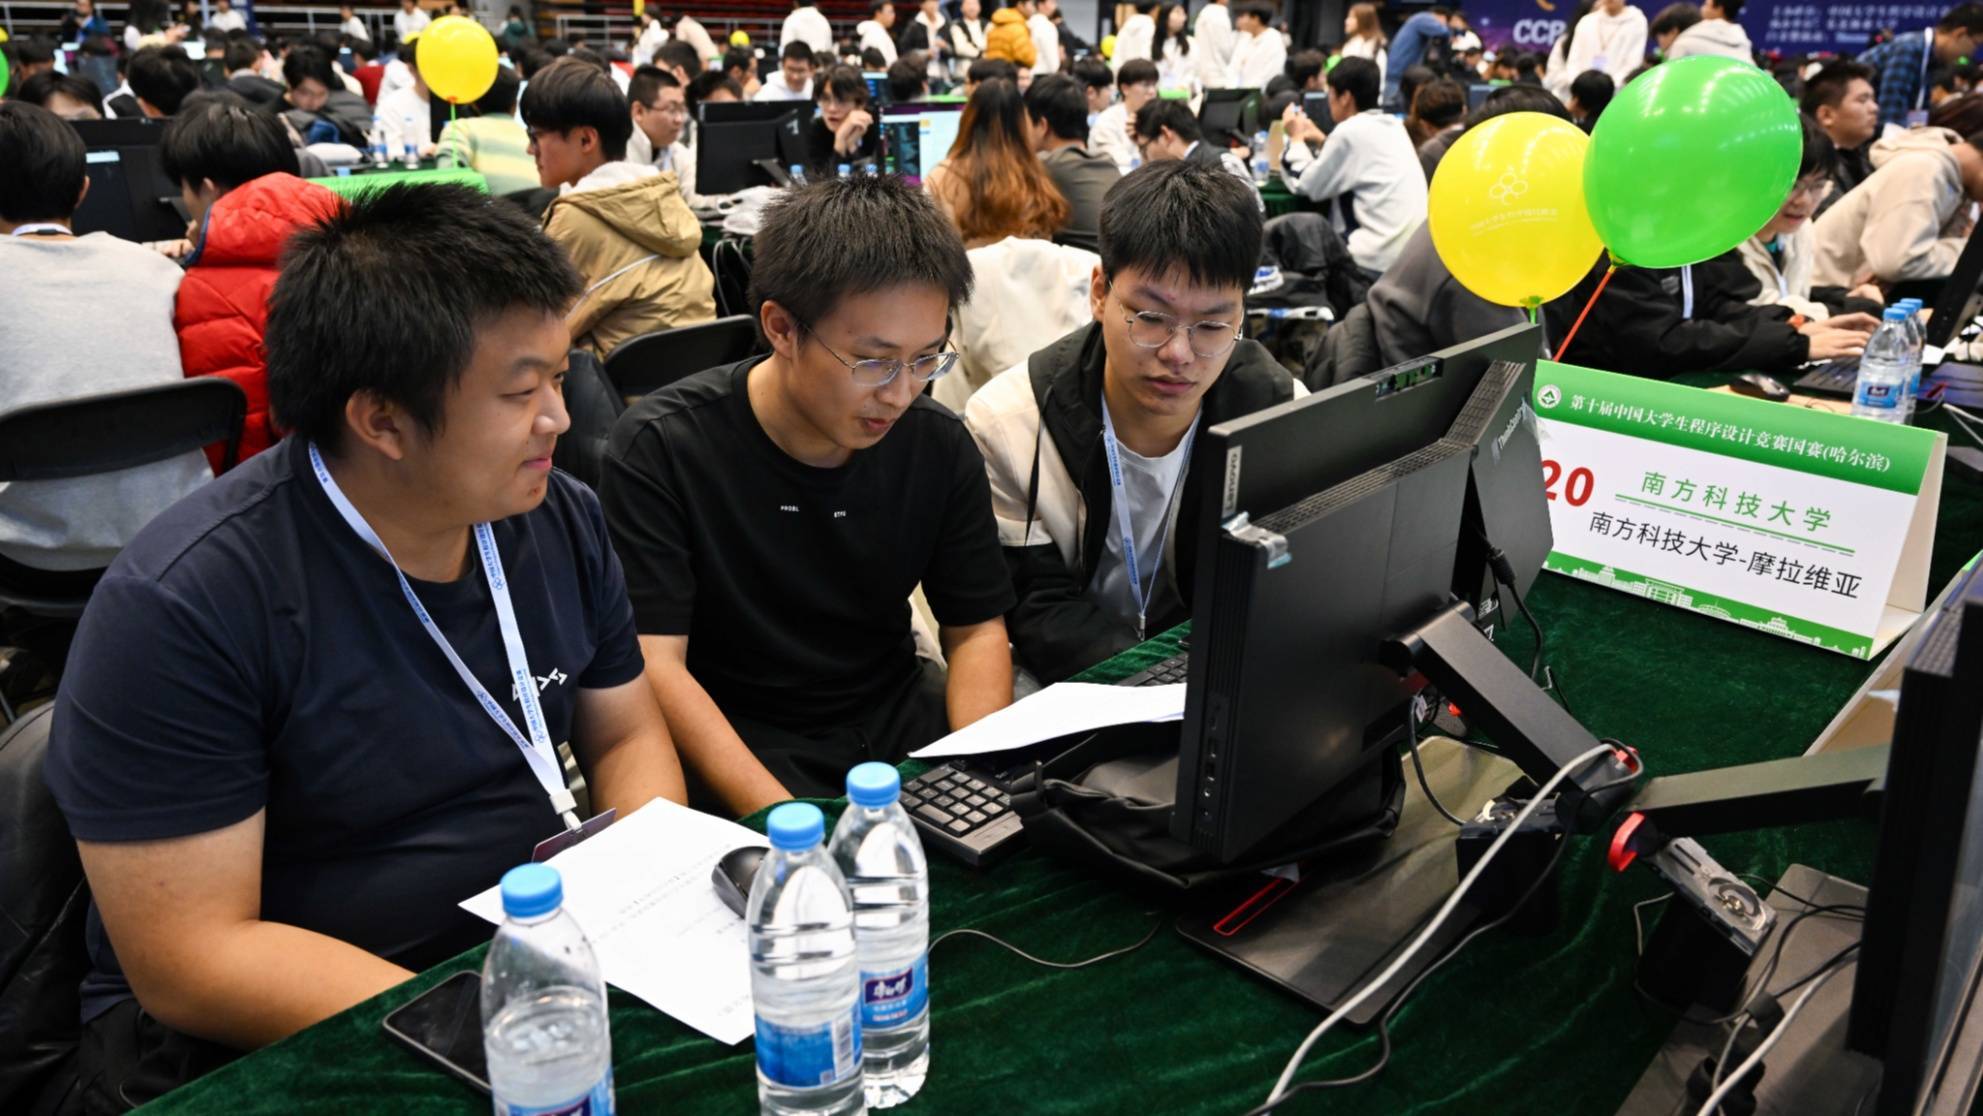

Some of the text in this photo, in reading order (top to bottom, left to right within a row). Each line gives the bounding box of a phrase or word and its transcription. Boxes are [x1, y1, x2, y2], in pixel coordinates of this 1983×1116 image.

[1569, 394, 1891, 472] 第十届中国大学生程序设计竞赛国赛(哈尔滨)
[1226, 452, 1238, 510] Lenovo
[1641, 471, 1832, 532] 南方科技大学
[1589, 511, 1862, 599] 南方科技大学-摩拉维亚
